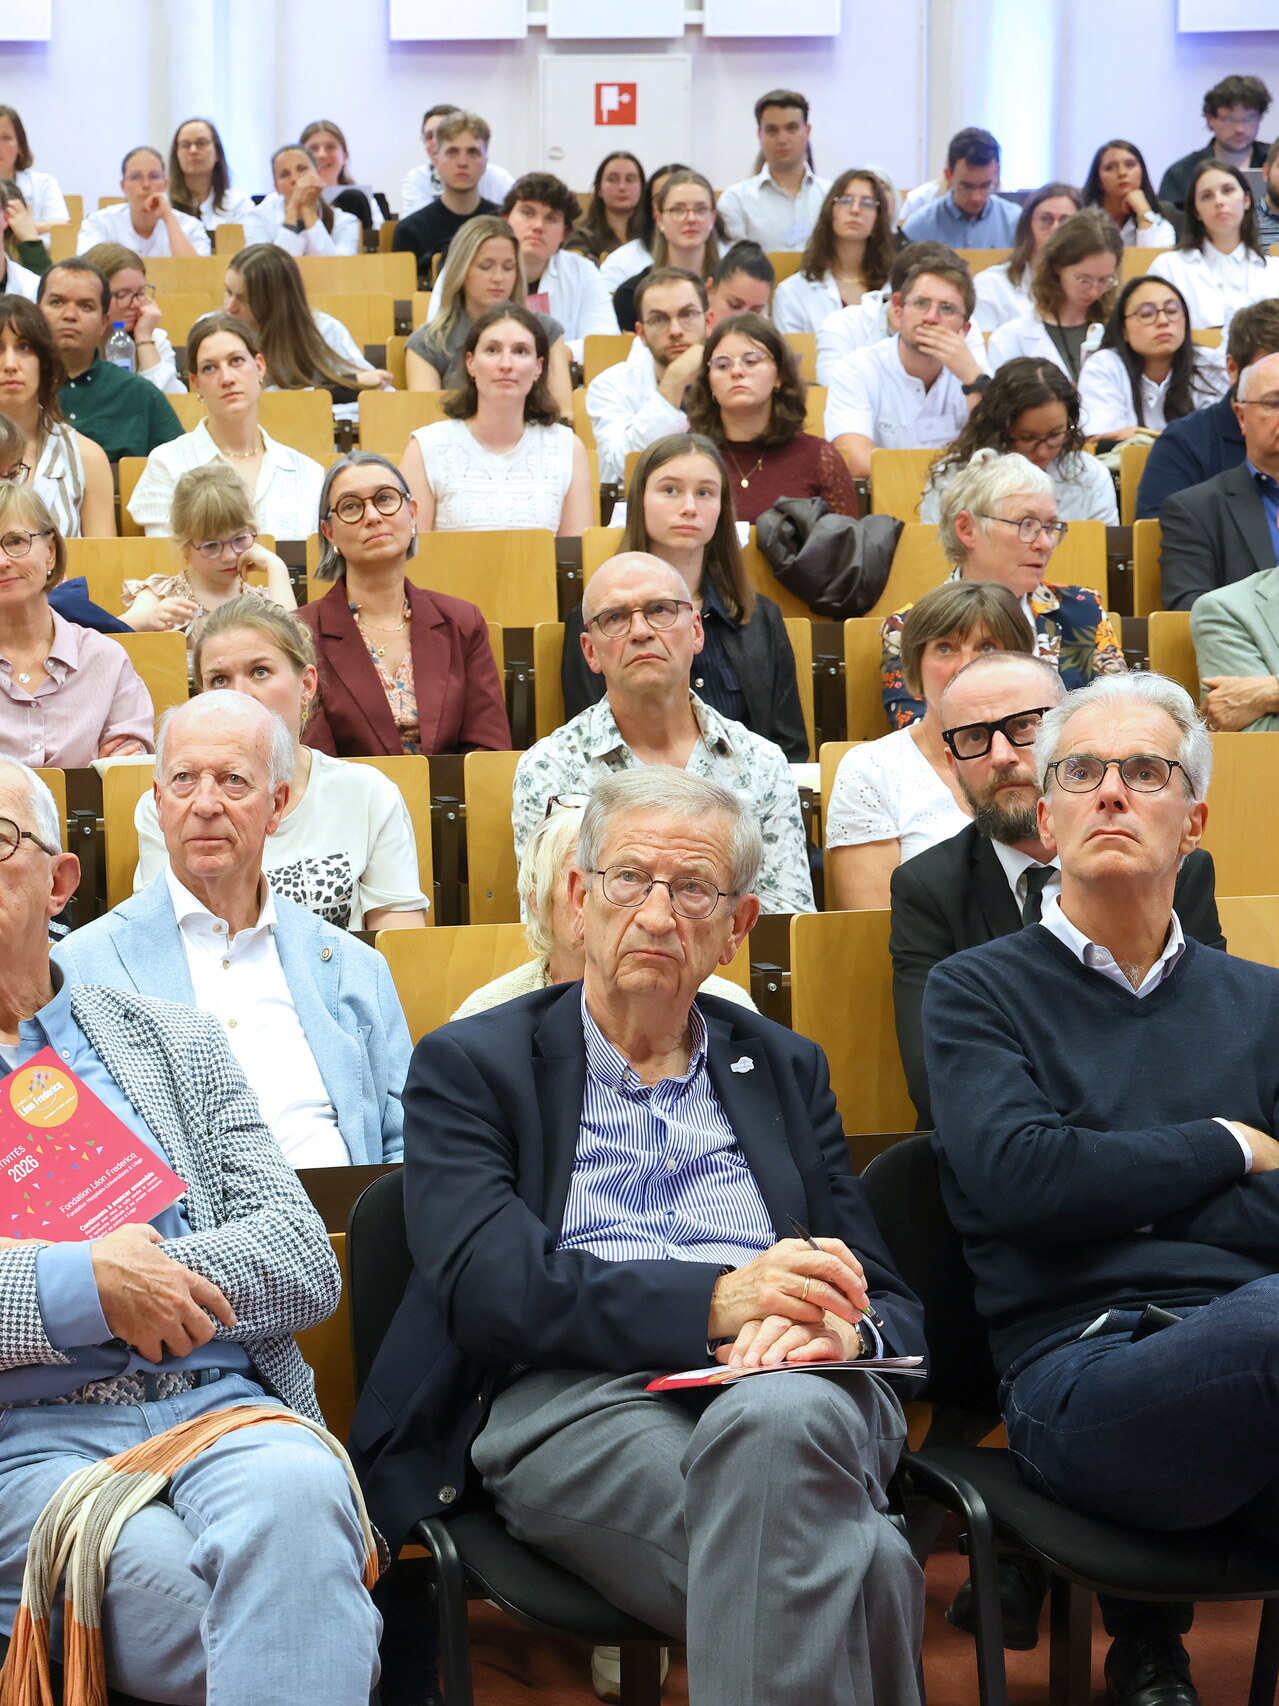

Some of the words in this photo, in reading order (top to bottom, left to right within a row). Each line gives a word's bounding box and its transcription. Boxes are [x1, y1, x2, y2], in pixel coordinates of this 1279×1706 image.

[17, 1101, 36, 1116] Léon
[32, 1081, 64, 1105] Fredericq
[6, 1153, 40, 1182] 2026
[59, 1187, 92, 1213] Fondation
[89, 1175, 107, 1189] Léon
[105, 1152, 137, 1176] Fredericq
[66, 1201, 87, 1218] Fondation
[131, 1157, 143, 1167] Liège
[78, 1208, 108, 1231] Continuons
[111, 1189, 131, 1206] avancer
[130, 1170, 154, 1191] ensemble
